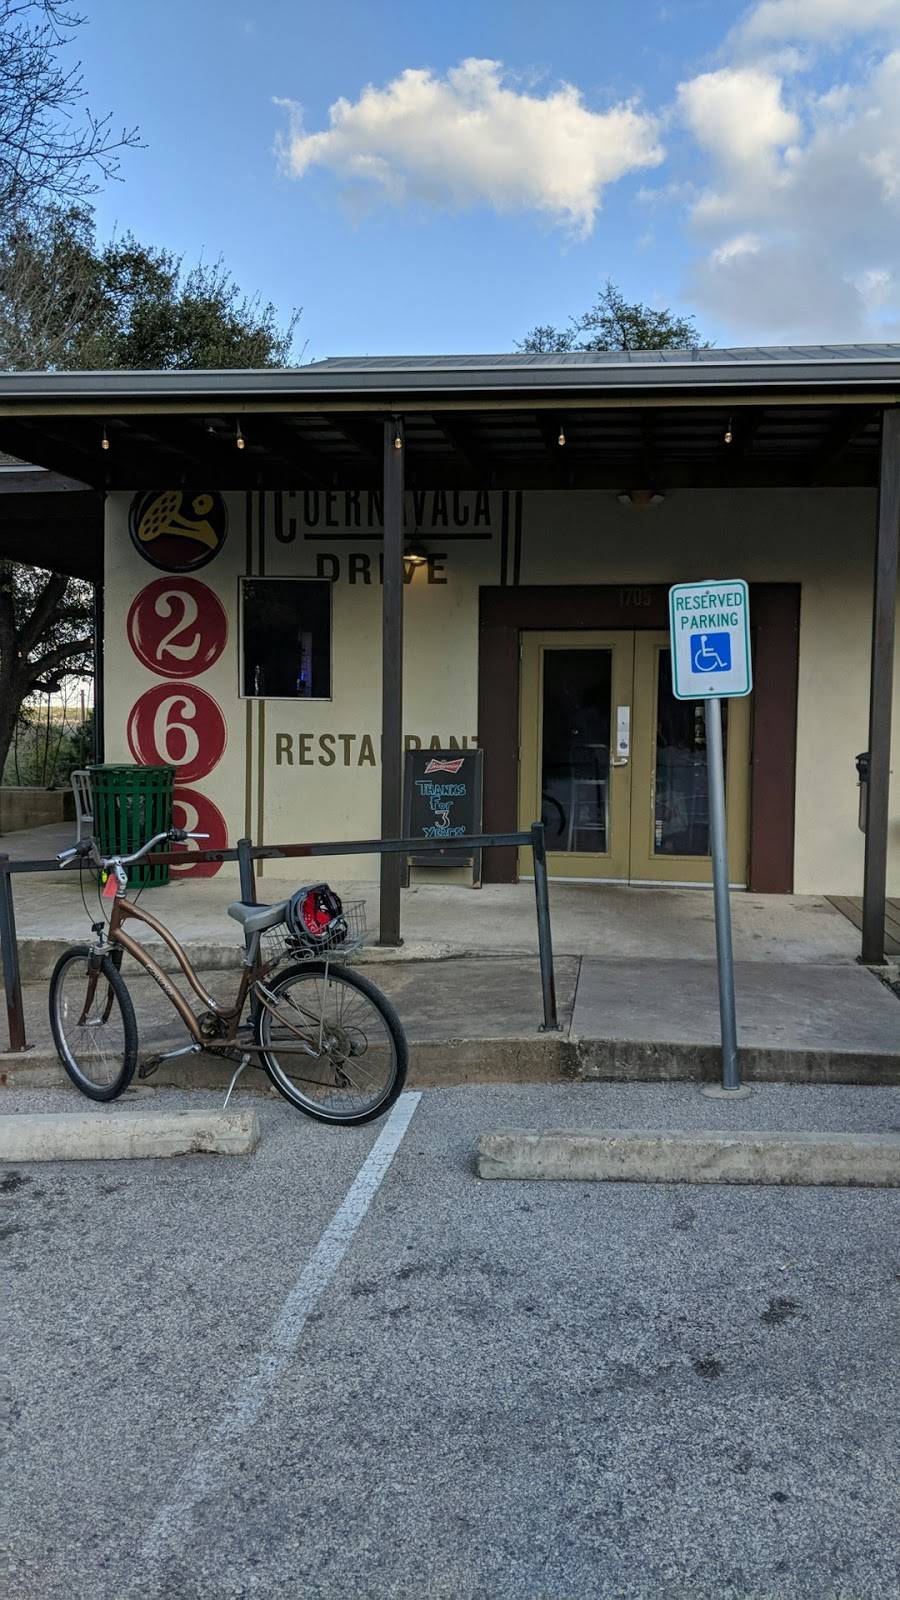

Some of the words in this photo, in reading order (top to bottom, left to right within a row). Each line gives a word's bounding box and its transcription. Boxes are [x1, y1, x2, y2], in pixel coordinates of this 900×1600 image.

[274, 490, 491, 543] CUERNVACA
[676, 592, 742, 611] RESERVED
[154, 590, 201, 661] 2
[681, 612, 739, 630] PARKING
[153, 695, 199, 765] 6
[275, 733, 479, 767] RESTA
[435, 810, 450, 828] 3
